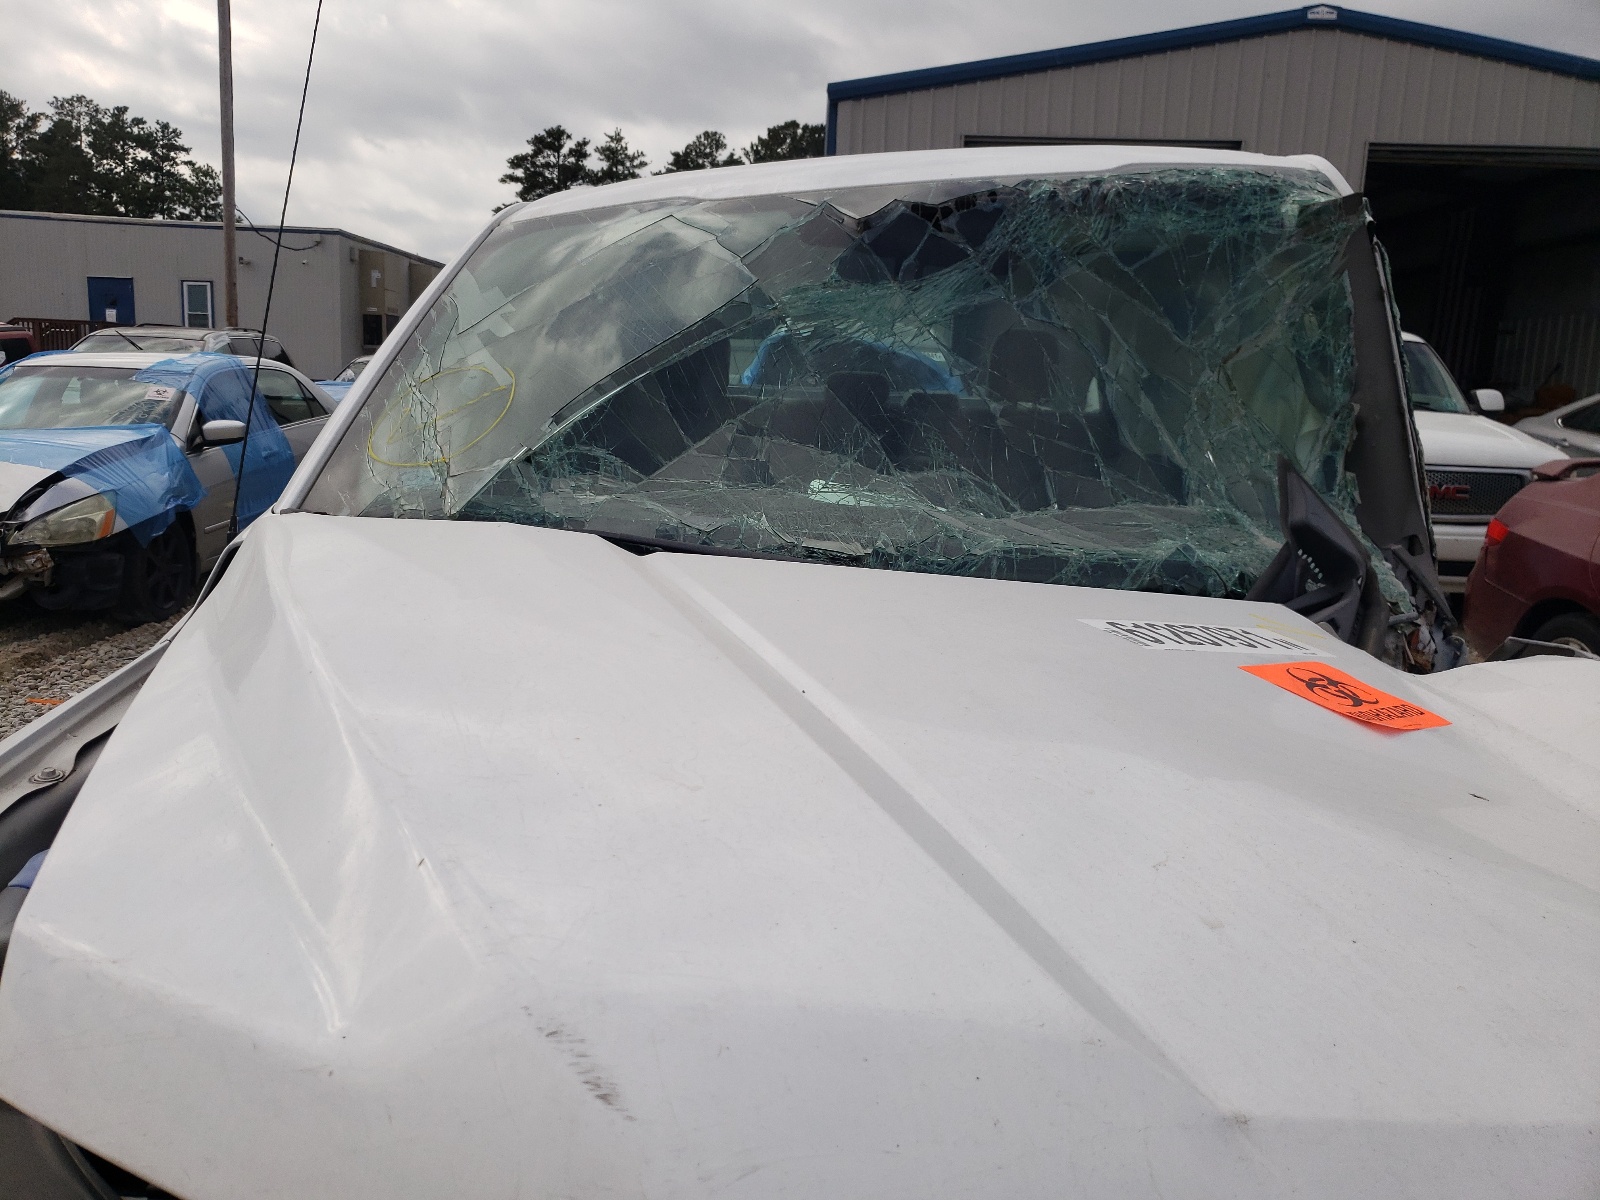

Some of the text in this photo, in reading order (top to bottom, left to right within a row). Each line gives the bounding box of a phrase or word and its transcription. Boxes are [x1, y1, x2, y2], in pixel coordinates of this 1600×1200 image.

[1428, 484, 1471, 500] MC
[1105, 621, 1293, 650] 61267971
[1346, 704, 1425, 722] OHAZARD
